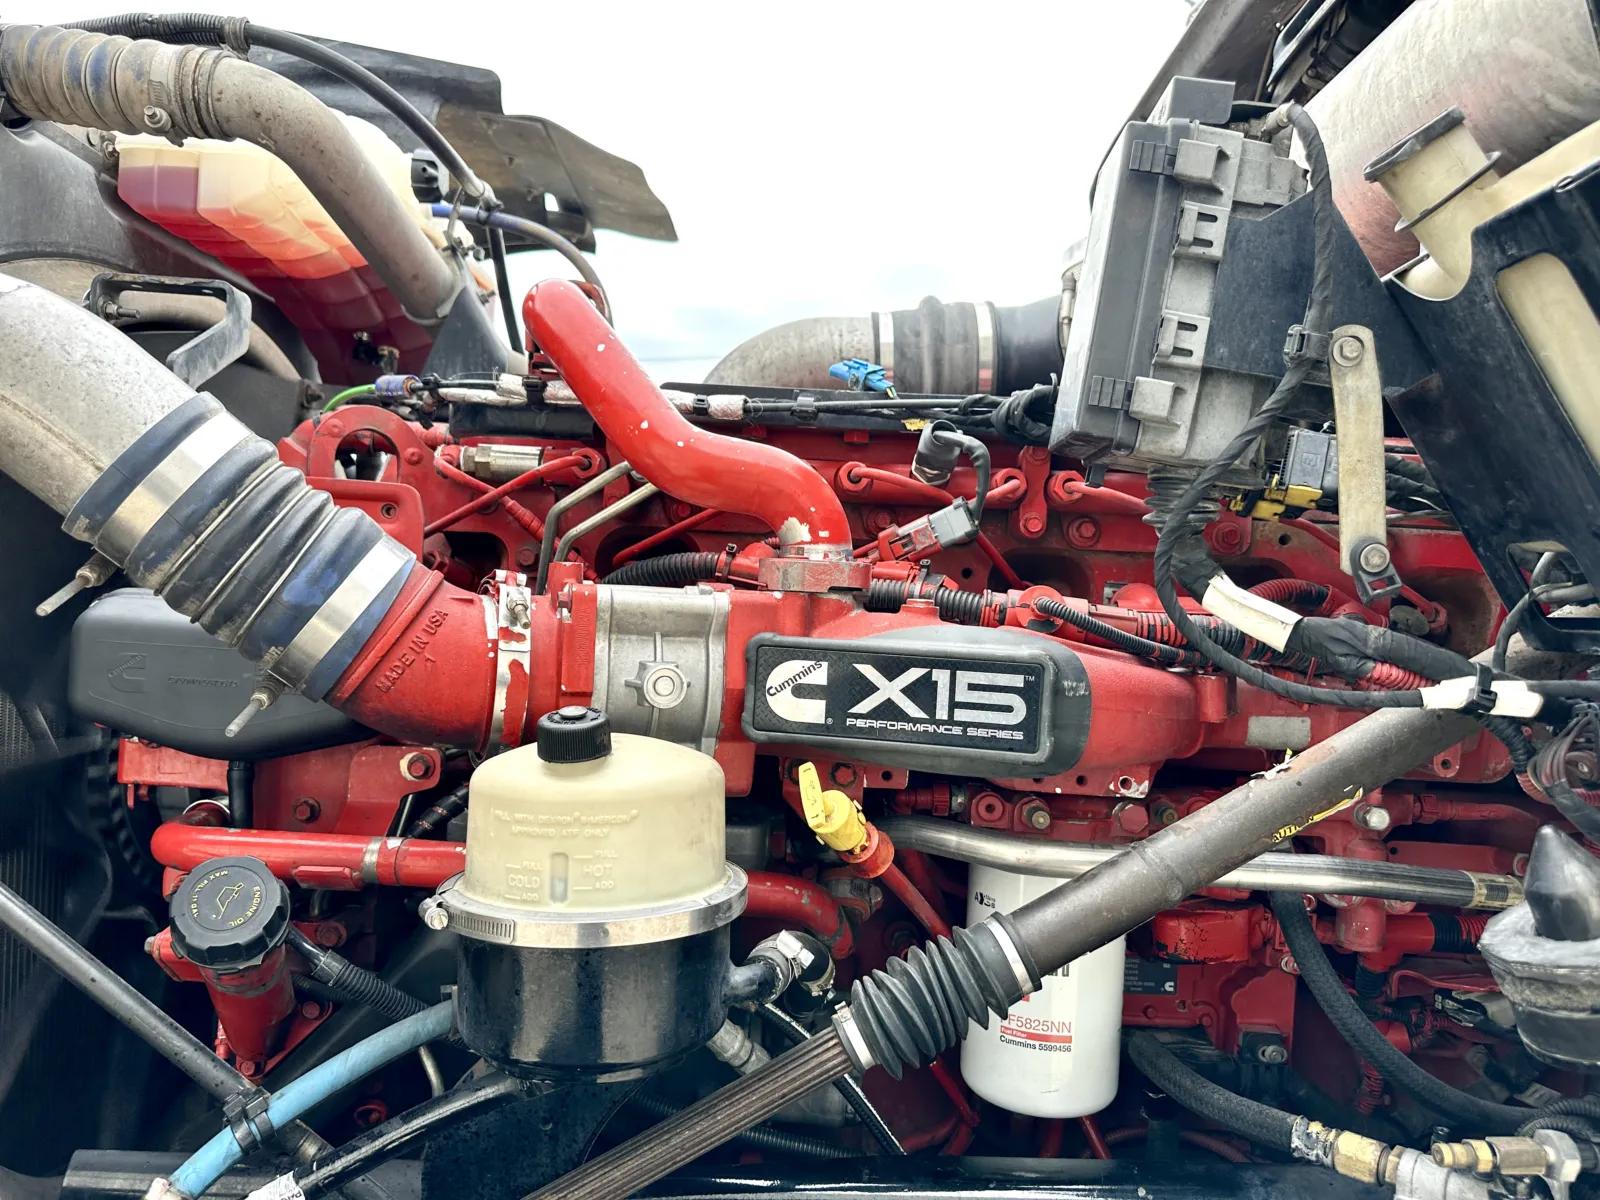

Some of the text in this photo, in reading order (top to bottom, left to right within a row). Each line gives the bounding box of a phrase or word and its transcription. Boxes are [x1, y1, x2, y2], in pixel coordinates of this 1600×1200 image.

[375, 610, 449, 693] MADE IN USA
[766, 660, 823, 697] Cummins
[847, 663, 1027, 726] X15
[846, 718, 1024, 740] PERFORMANCE SERIES
[209, 869, 229, 881] MAX
[508, 873, 540, 889] COLD
[584, 864, 613, 878] HOT
[195, 879, 209, 892] FILL
[595, 880, 615, 890] ADD
[228, 885, 261, 928] ENGINE OIL
[1001, 1013, 1072, 1034] F5825NN
[999, 1034, 1072, 1053] Cummins 5599456
